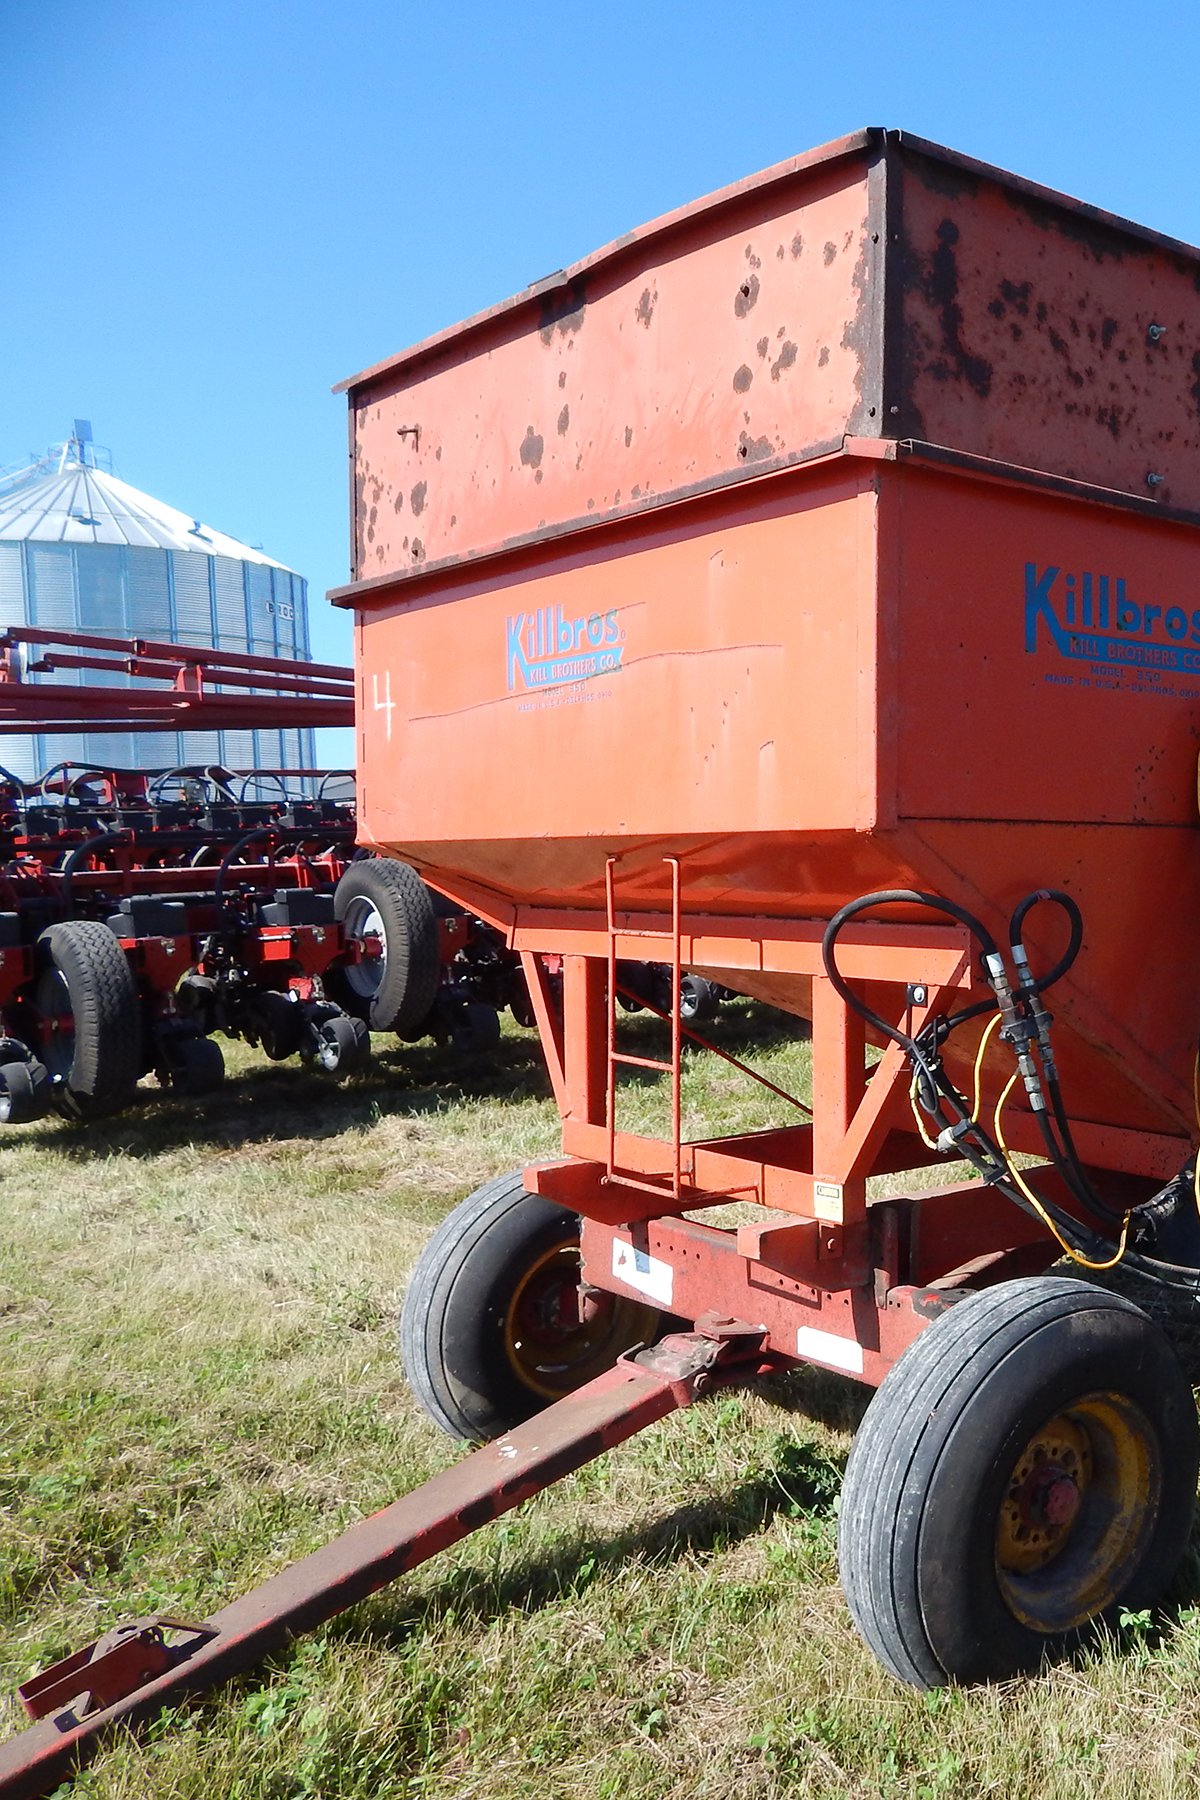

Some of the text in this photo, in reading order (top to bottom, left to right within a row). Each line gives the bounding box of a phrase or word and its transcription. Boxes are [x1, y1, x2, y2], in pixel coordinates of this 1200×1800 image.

[506, 604, 619, 690] Killbros
[1069, 638, 1099, 656] KILL
[1107, 644, 1177, 666] BROTHERS
[530, 654, 617, 684] KILL BROTHERS CO.
[1090, 666, 1126, 679] MODEL
